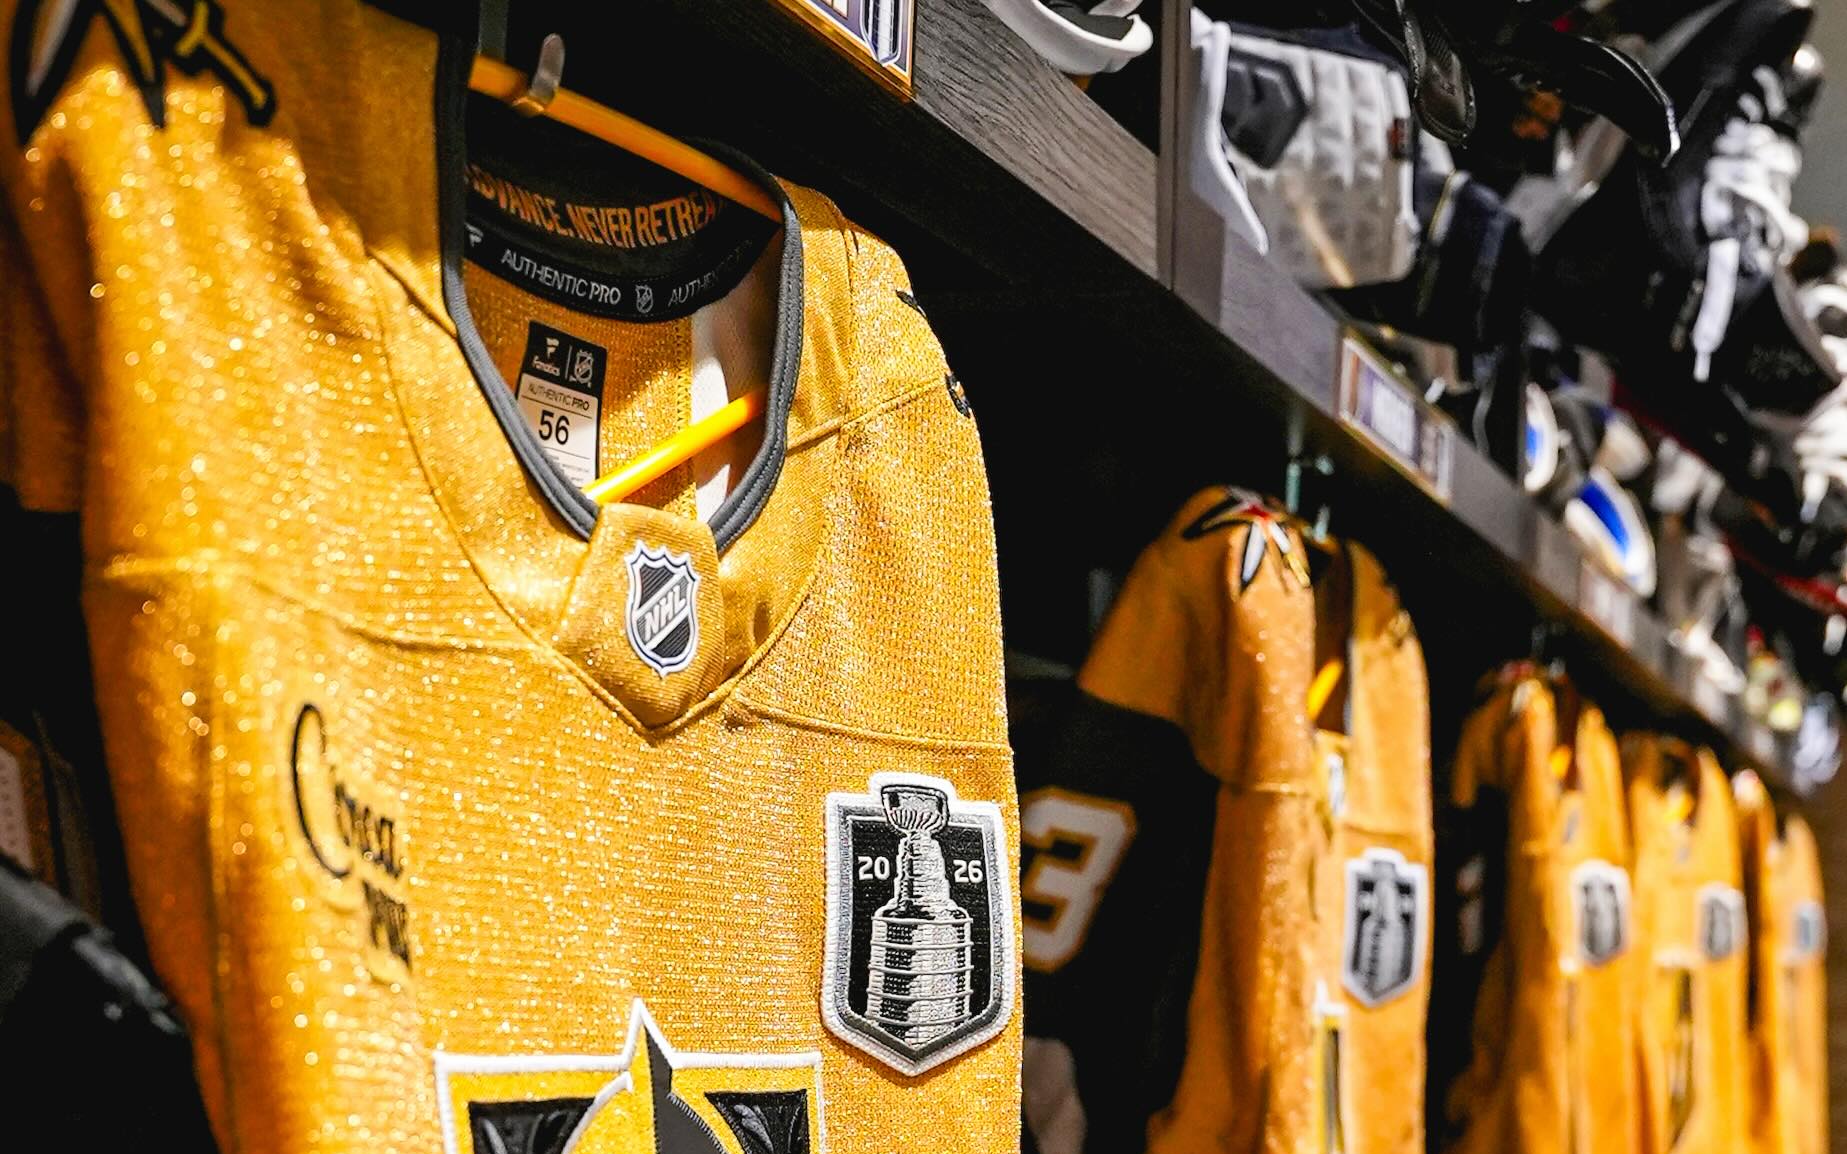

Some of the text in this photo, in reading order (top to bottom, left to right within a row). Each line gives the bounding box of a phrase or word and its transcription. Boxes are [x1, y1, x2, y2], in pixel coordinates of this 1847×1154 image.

[501, 248, 588, 298] AUTHENTIC
[588, 280, 622, 305] PRO
[571, 396, 591, 412] PRO
[538, 409, 571, 446] 56
[643, 582, 687, 642] NHL
[858, 855, 984, 884] 20 26
